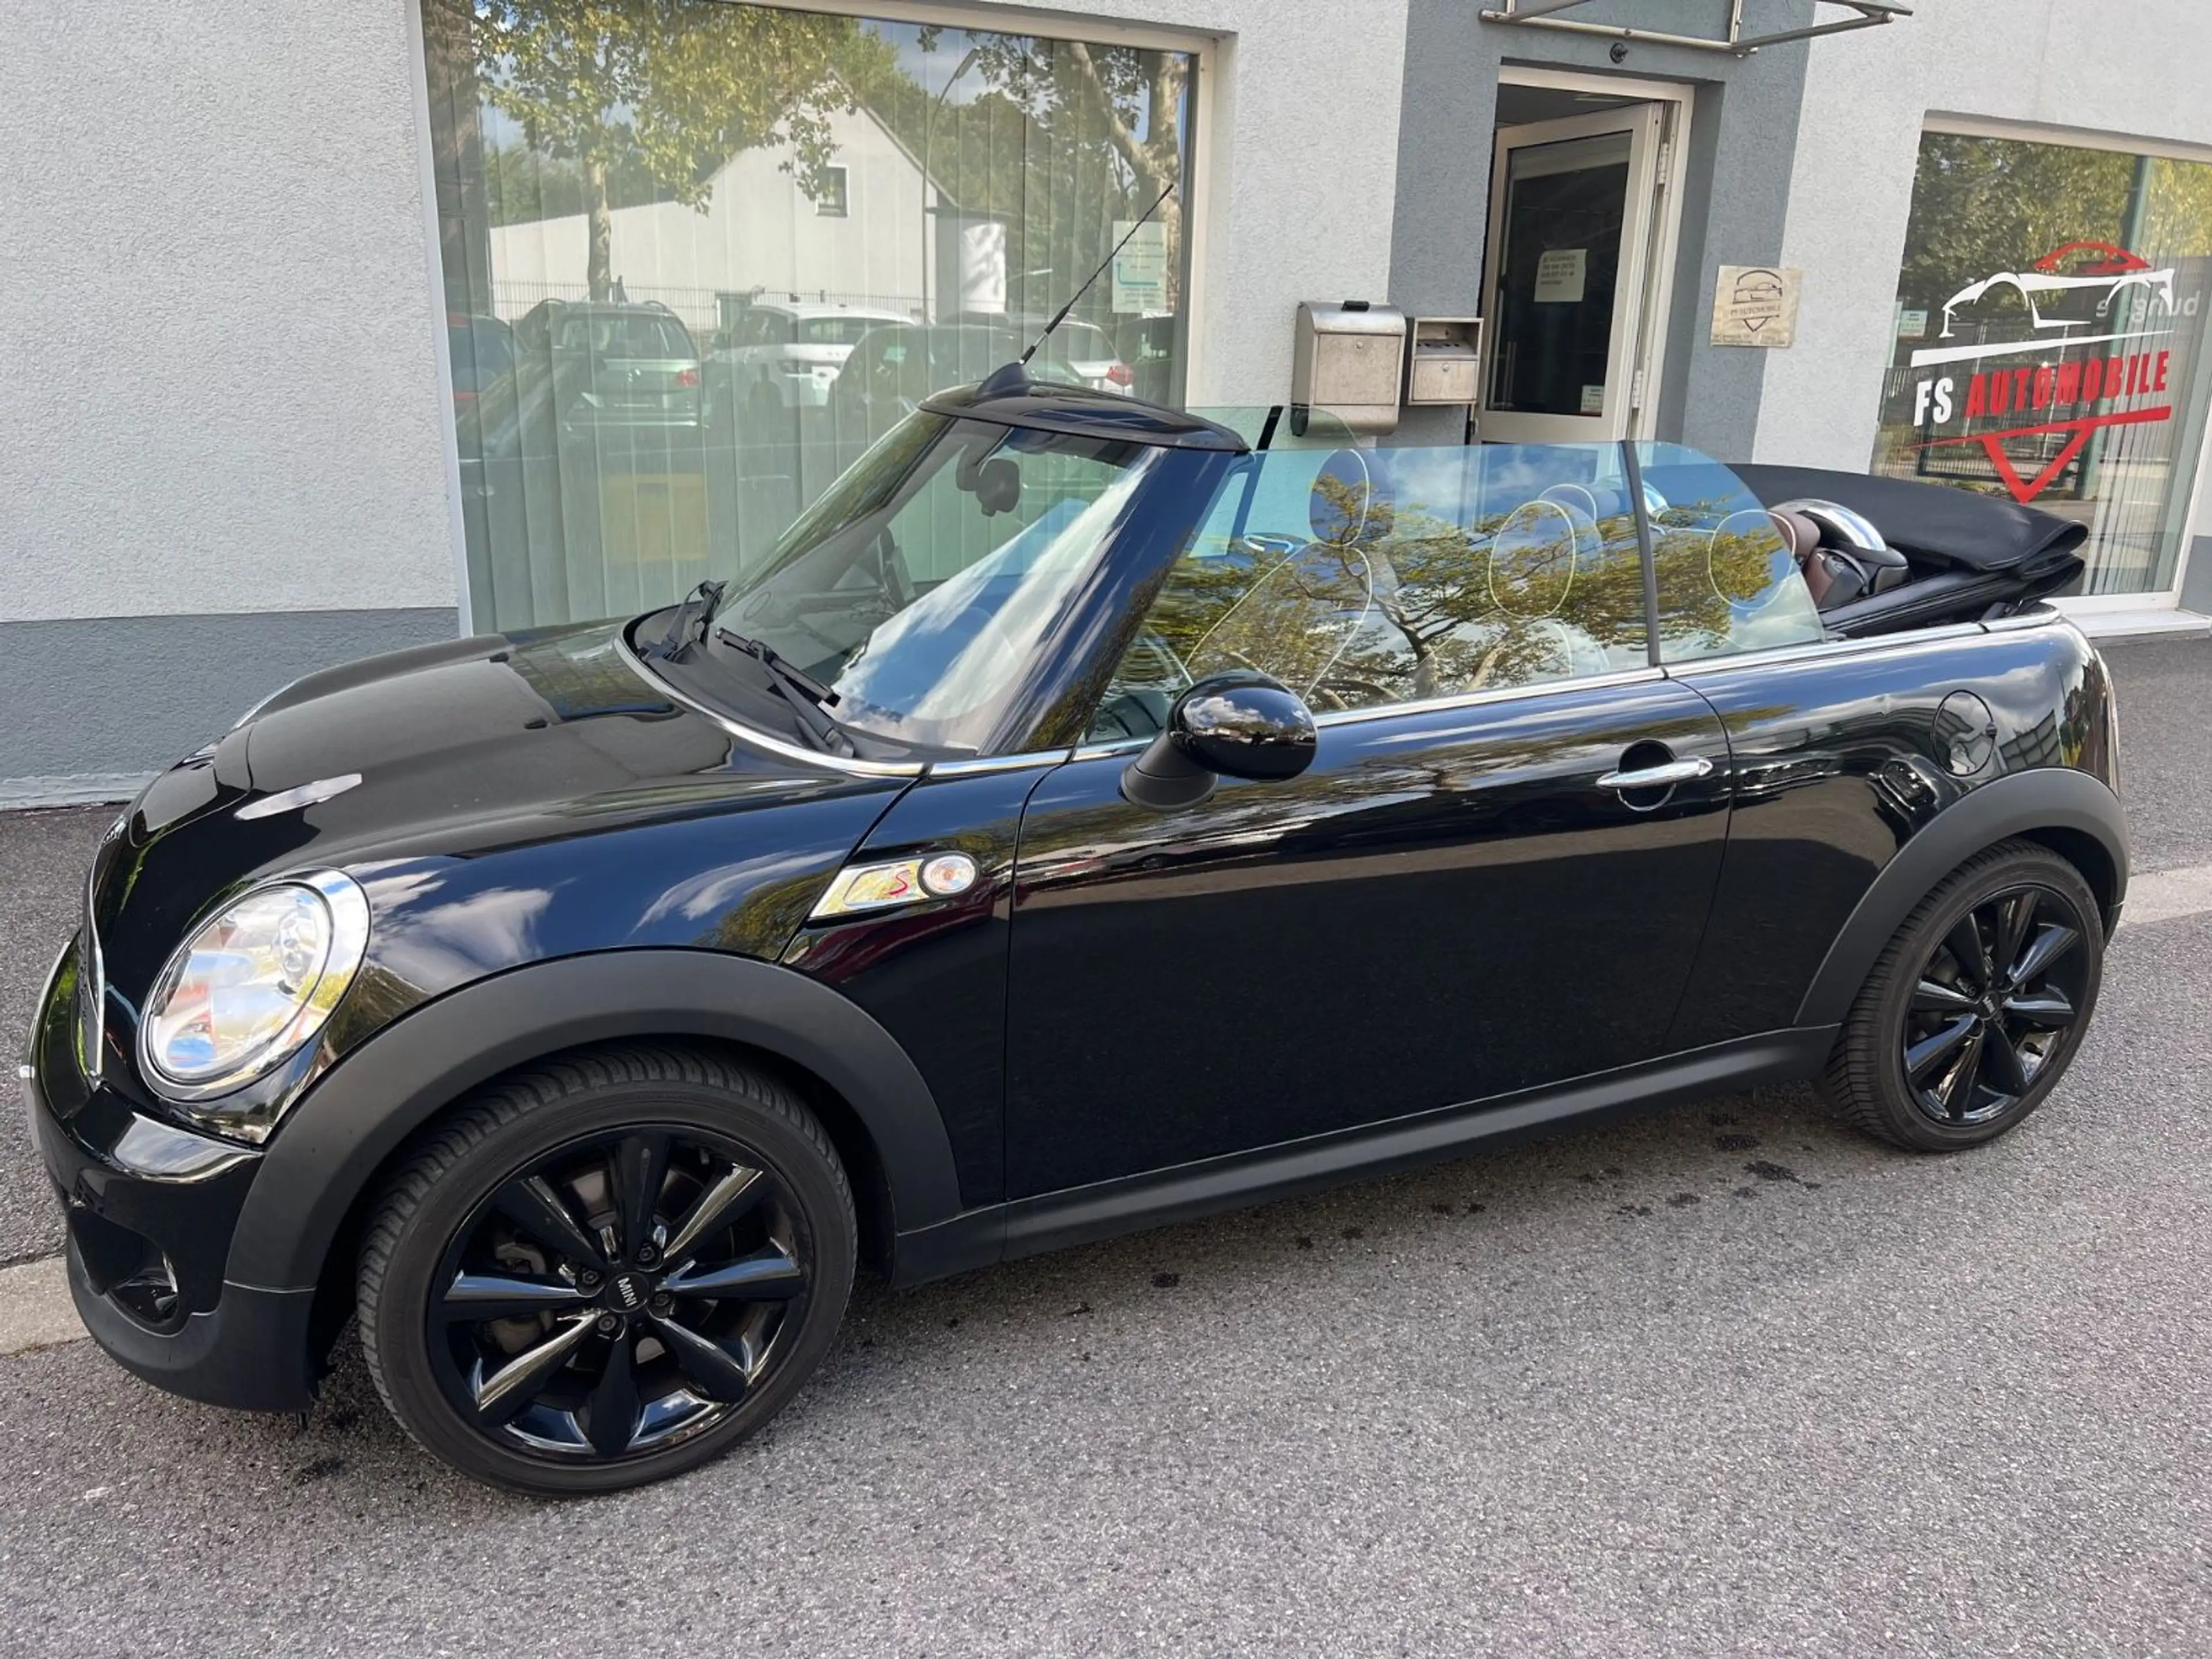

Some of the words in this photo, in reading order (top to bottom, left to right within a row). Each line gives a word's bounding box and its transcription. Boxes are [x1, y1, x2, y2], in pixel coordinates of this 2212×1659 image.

[1914, 377, 1953, 426] FS
[1964, 350, 2169, 418] AUTOMOBILE
[618, 1277, 638, 1307] MINI
